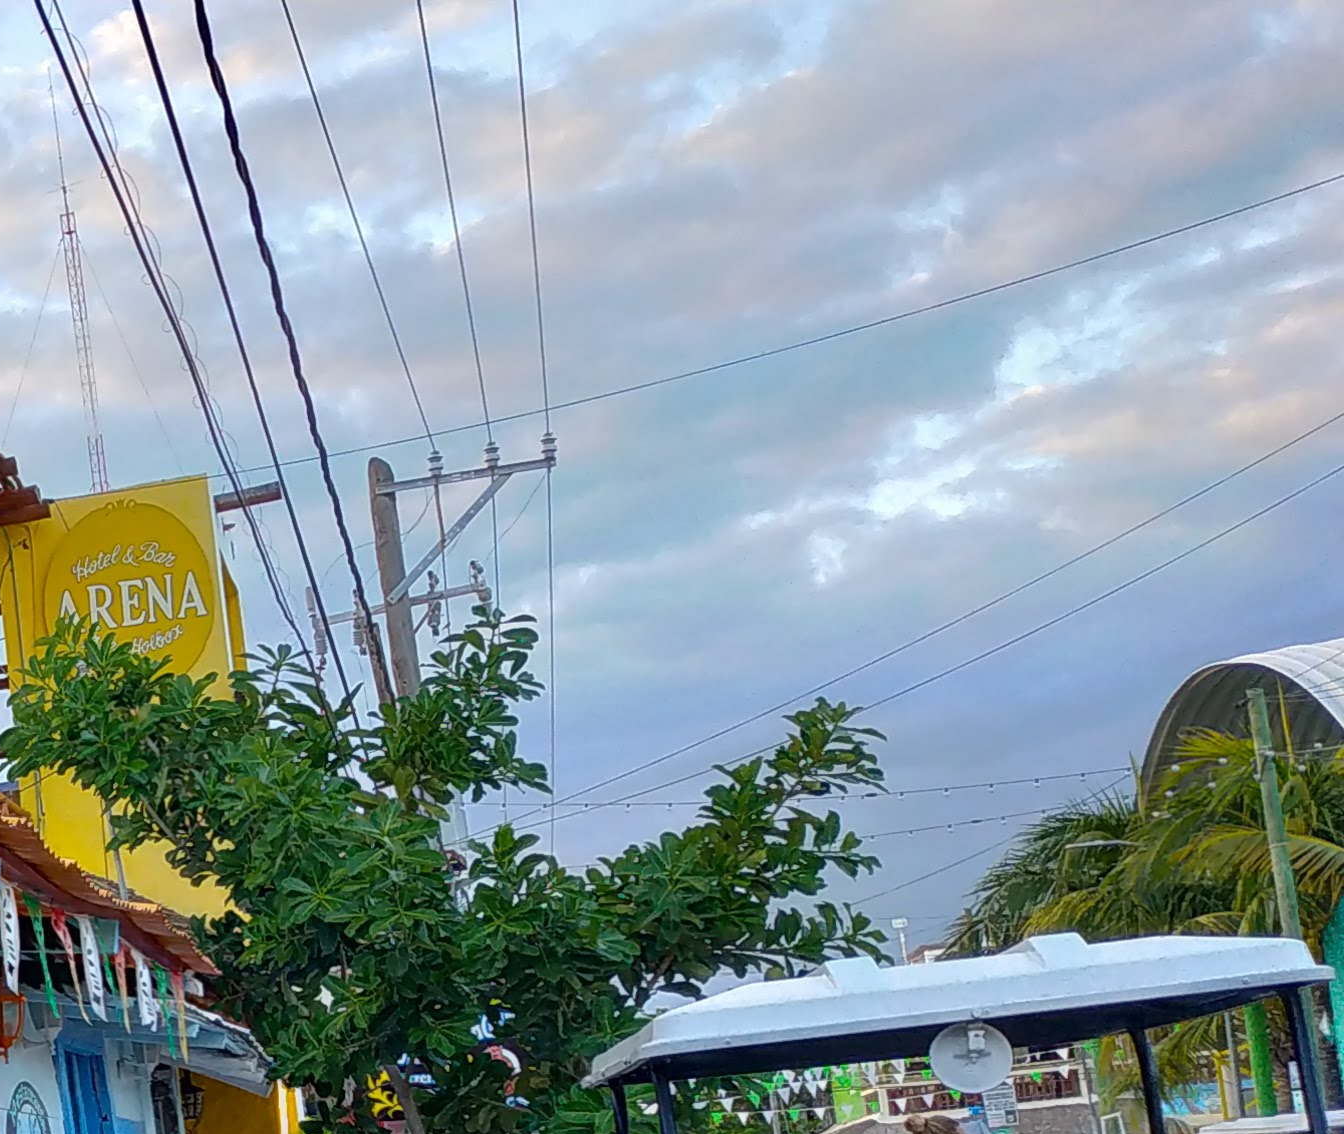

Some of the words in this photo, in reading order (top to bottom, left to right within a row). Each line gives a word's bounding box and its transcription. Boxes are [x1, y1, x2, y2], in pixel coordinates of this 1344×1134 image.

[72, 544, 122, 583] Hotel
[121, 544, 141, 567] &
[138, 541, 176, 567] Bar
[59, 570, 209, 630] ARENA
[130, 624, 185, 655] Holbox
